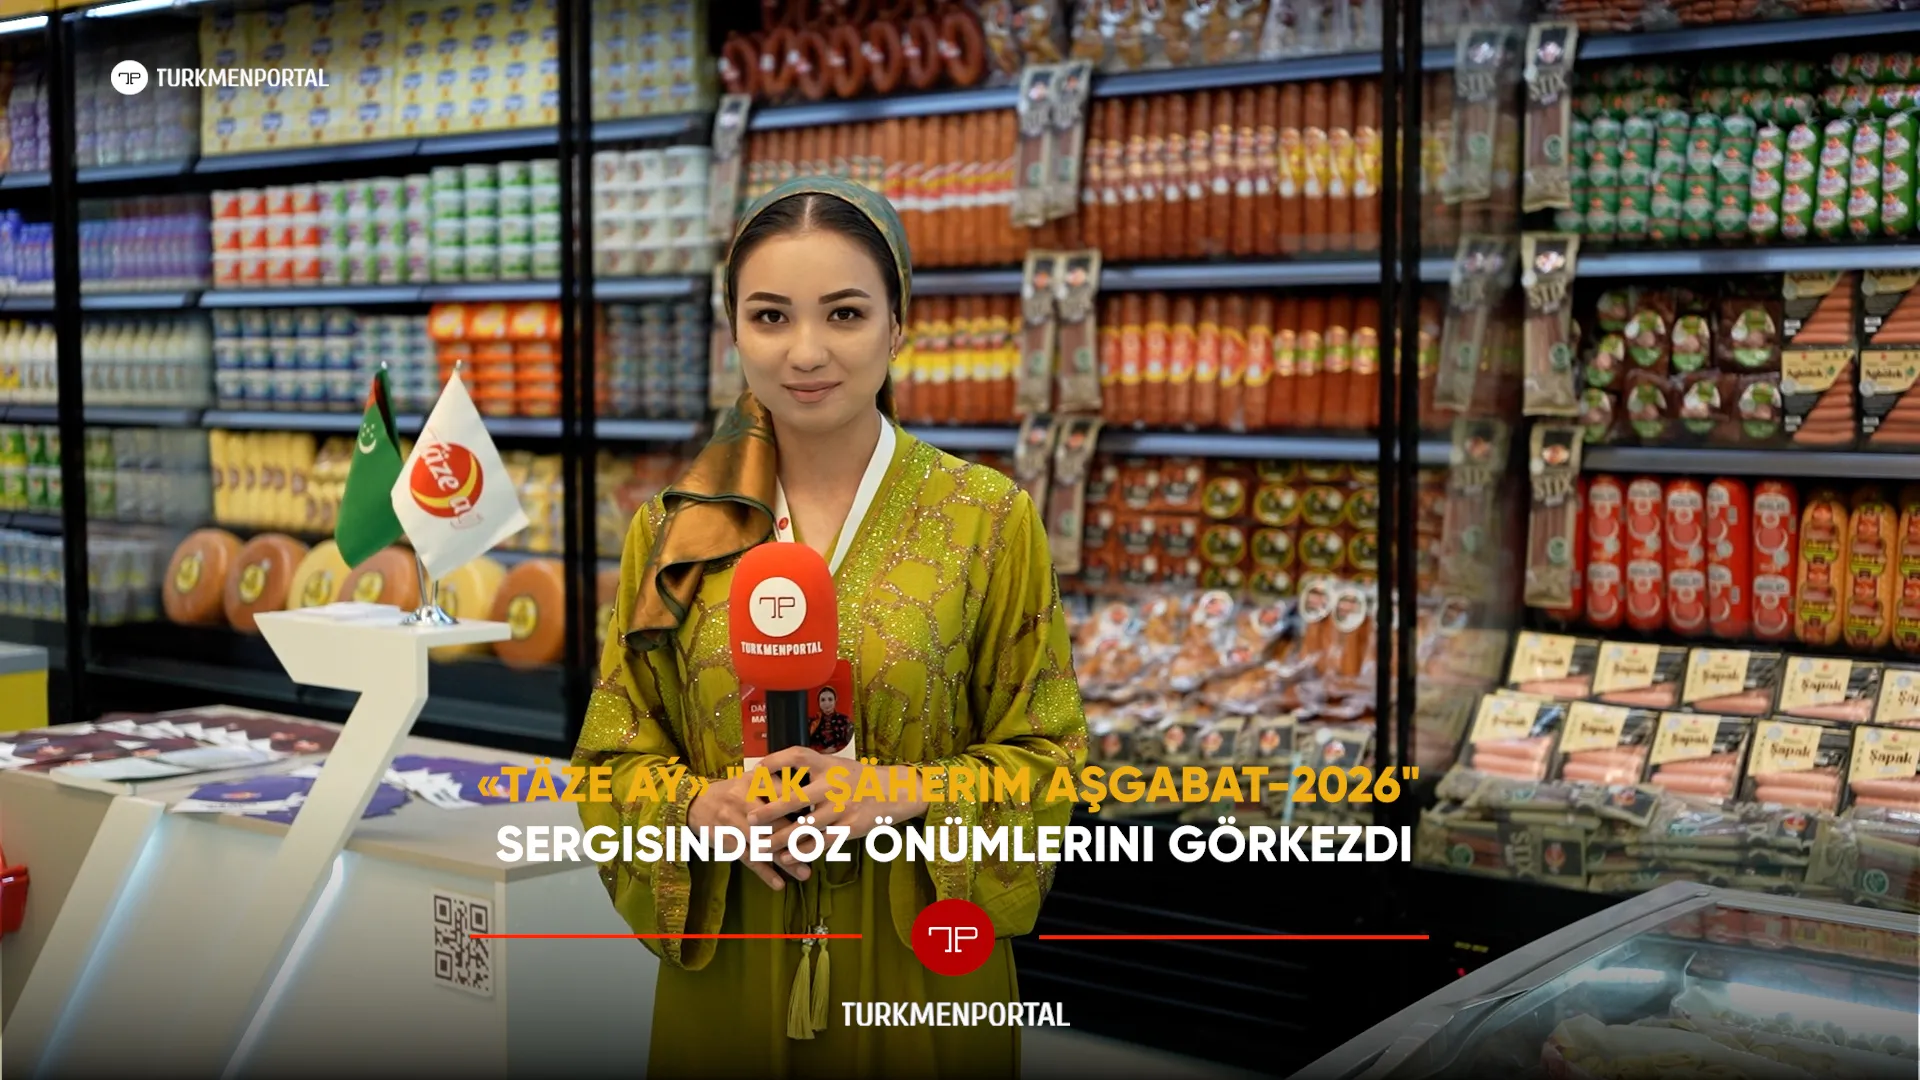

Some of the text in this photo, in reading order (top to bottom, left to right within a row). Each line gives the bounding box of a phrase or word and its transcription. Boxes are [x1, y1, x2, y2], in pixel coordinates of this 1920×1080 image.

[740, 640, 824, 657] TURKMENPORTAL
[1800, 677, 1842, 698] Şapak
[1769, 742, 1812, 761] Şapak
[1869, 748, 1914, 769] Şapak
